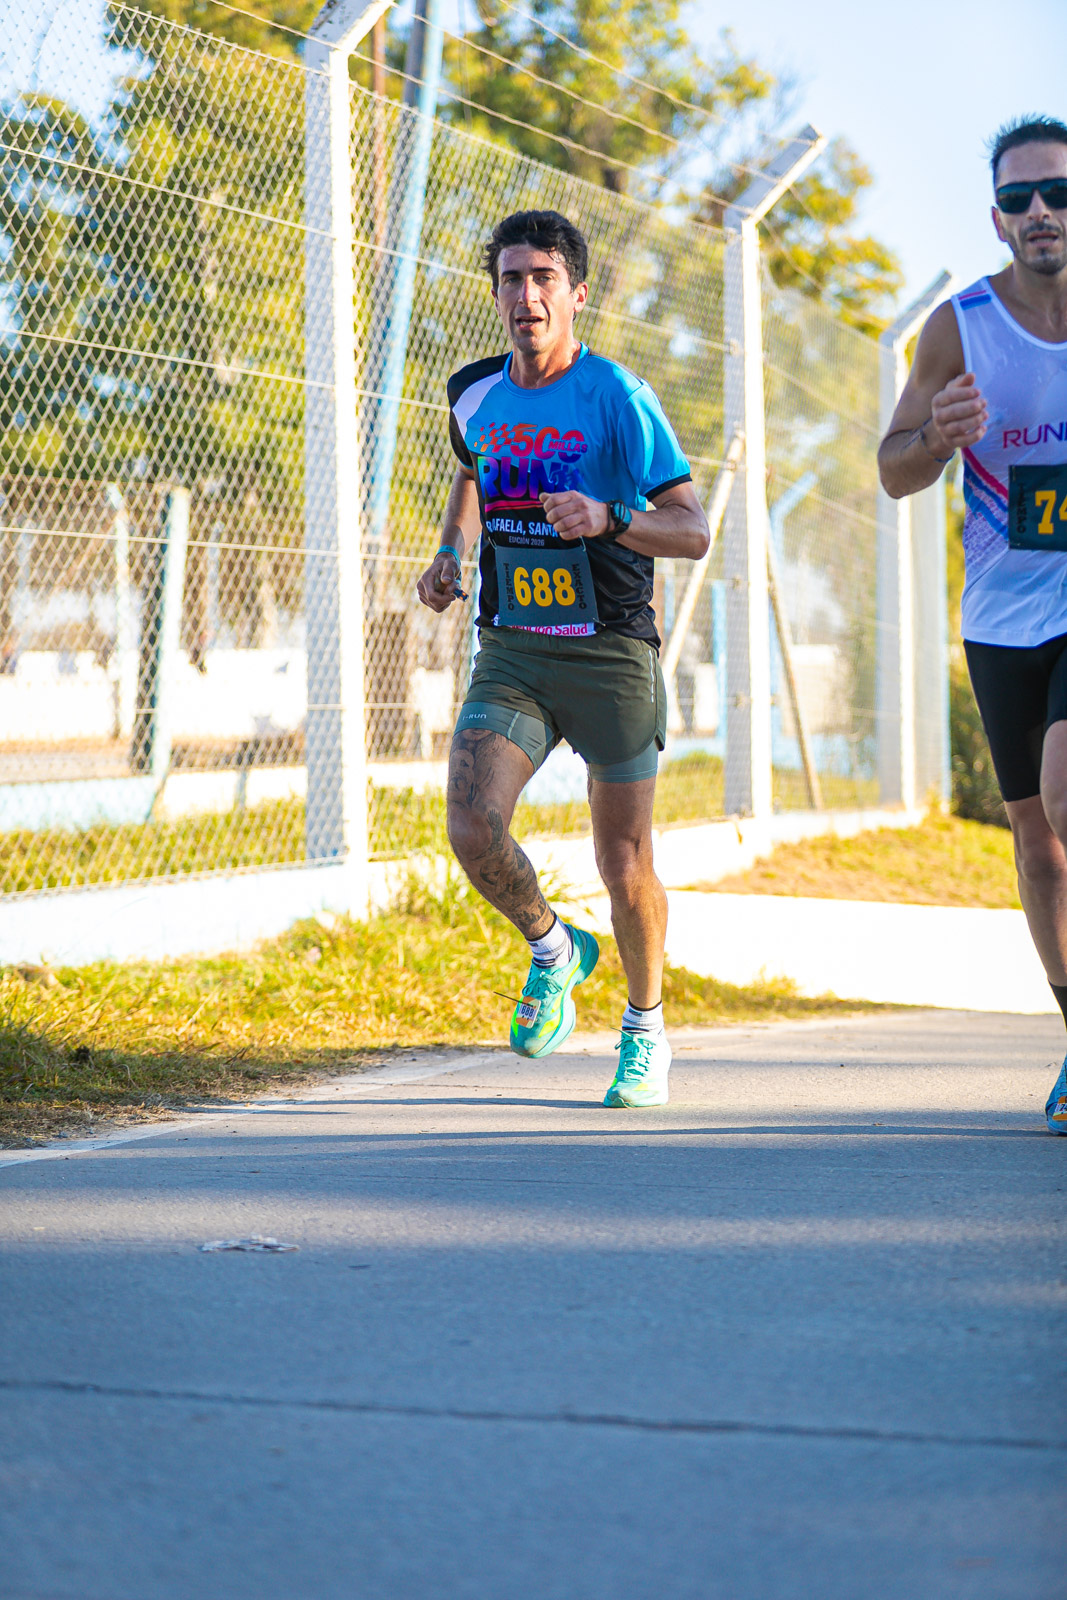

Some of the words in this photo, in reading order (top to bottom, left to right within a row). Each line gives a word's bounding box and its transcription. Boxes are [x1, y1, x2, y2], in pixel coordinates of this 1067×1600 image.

[548, 440, 588, 453] MILLAS
[1003, 421, 1067, 449] RUN
[486, 518, 526, 536] RAFAELA,
[503, 562, 515, 611] TIEMPO
[513, 566, 576, 608] 688
[572, 563, 588, 610] EXACTO
[554, 623, 588, 636] Salud
[521, 1005, 534, 1017] 688
